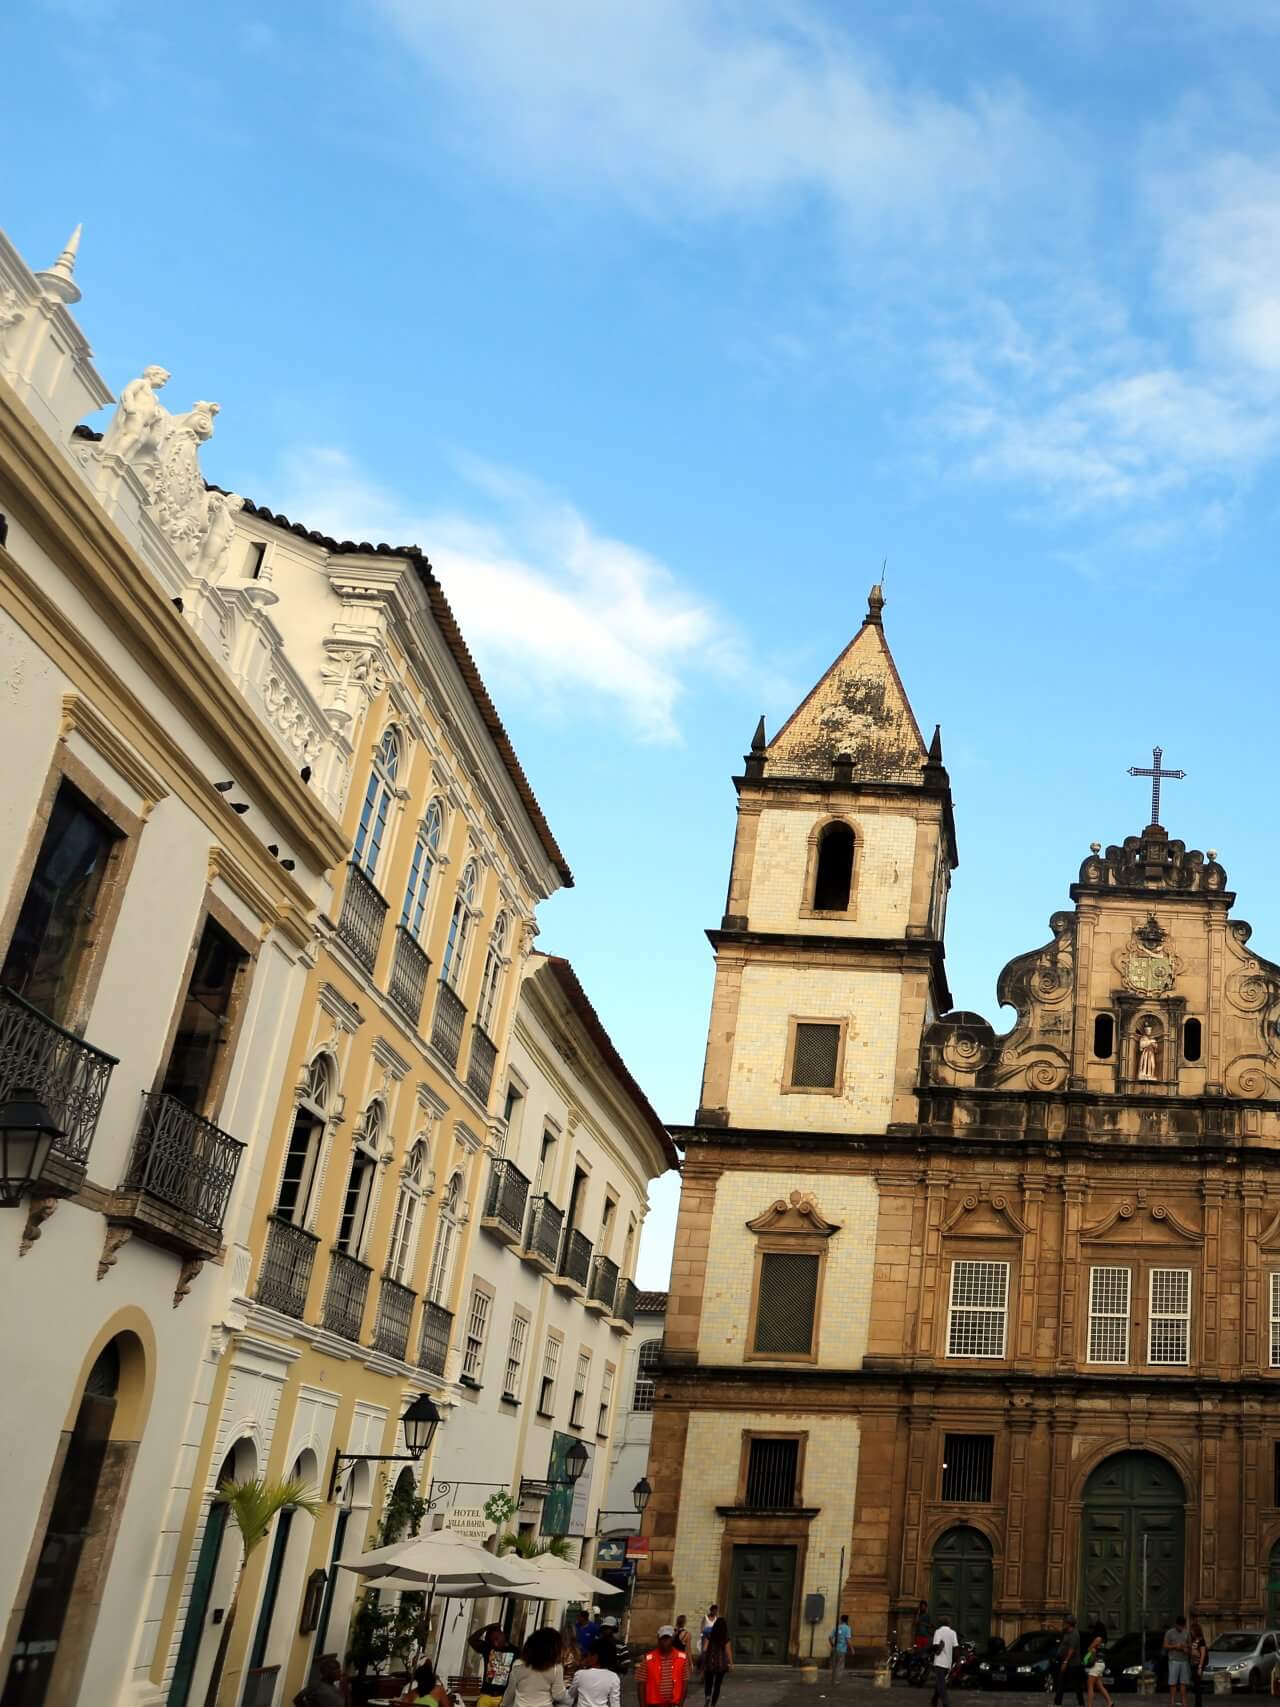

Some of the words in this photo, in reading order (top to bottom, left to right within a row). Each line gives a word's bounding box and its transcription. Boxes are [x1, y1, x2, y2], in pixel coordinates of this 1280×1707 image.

[453, 1509, 481, 1517] HOTEL
[448, 1519, 465, 1527] VILLA
[466, 1520, 485, 1528] BAHIA
